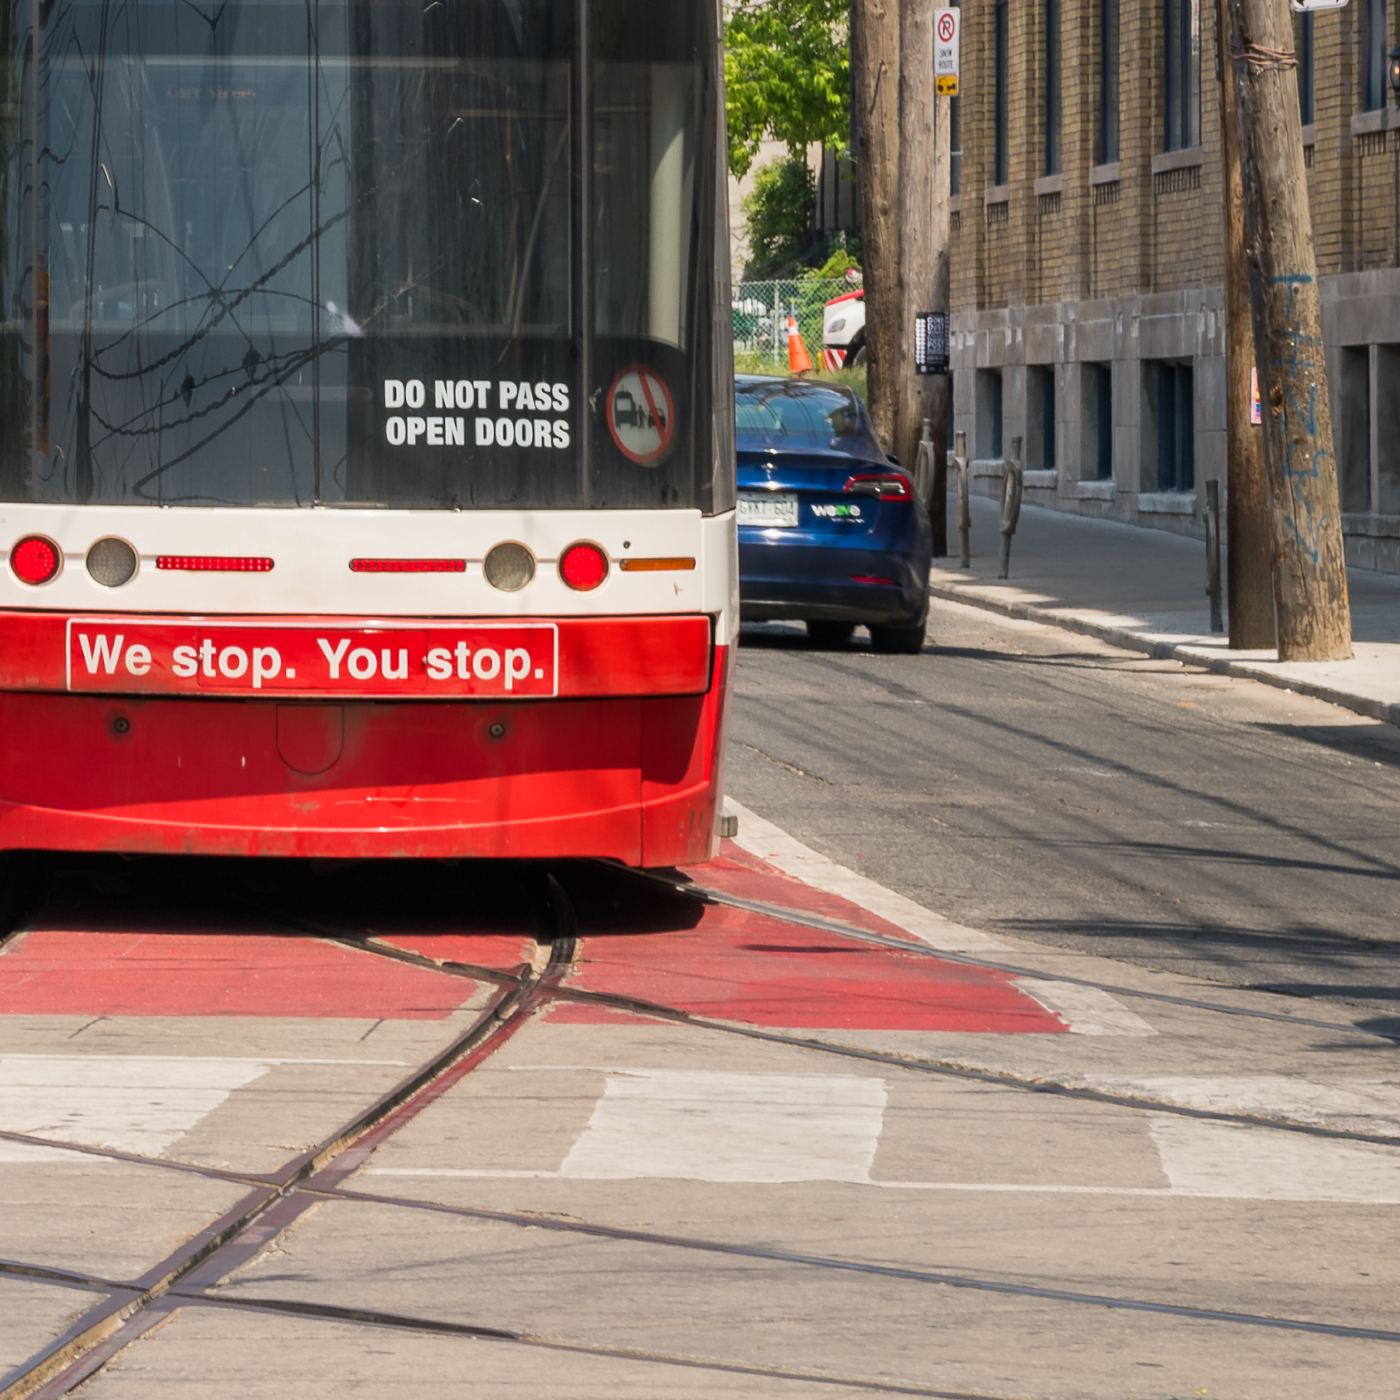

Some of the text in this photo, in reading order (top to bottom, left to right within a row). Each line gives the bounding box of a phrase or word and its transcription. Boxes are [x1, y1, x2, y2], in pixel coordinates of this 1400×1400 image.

[939, 49, 953, 58] SNOW
[939, 60, 953, 69] ROUTE
[384, 379, 570, 412] DO NOT PASS
[386, 416, 570, 449] OPEN DOORS
[78, 633, 544, 690] We stop. You stop.
